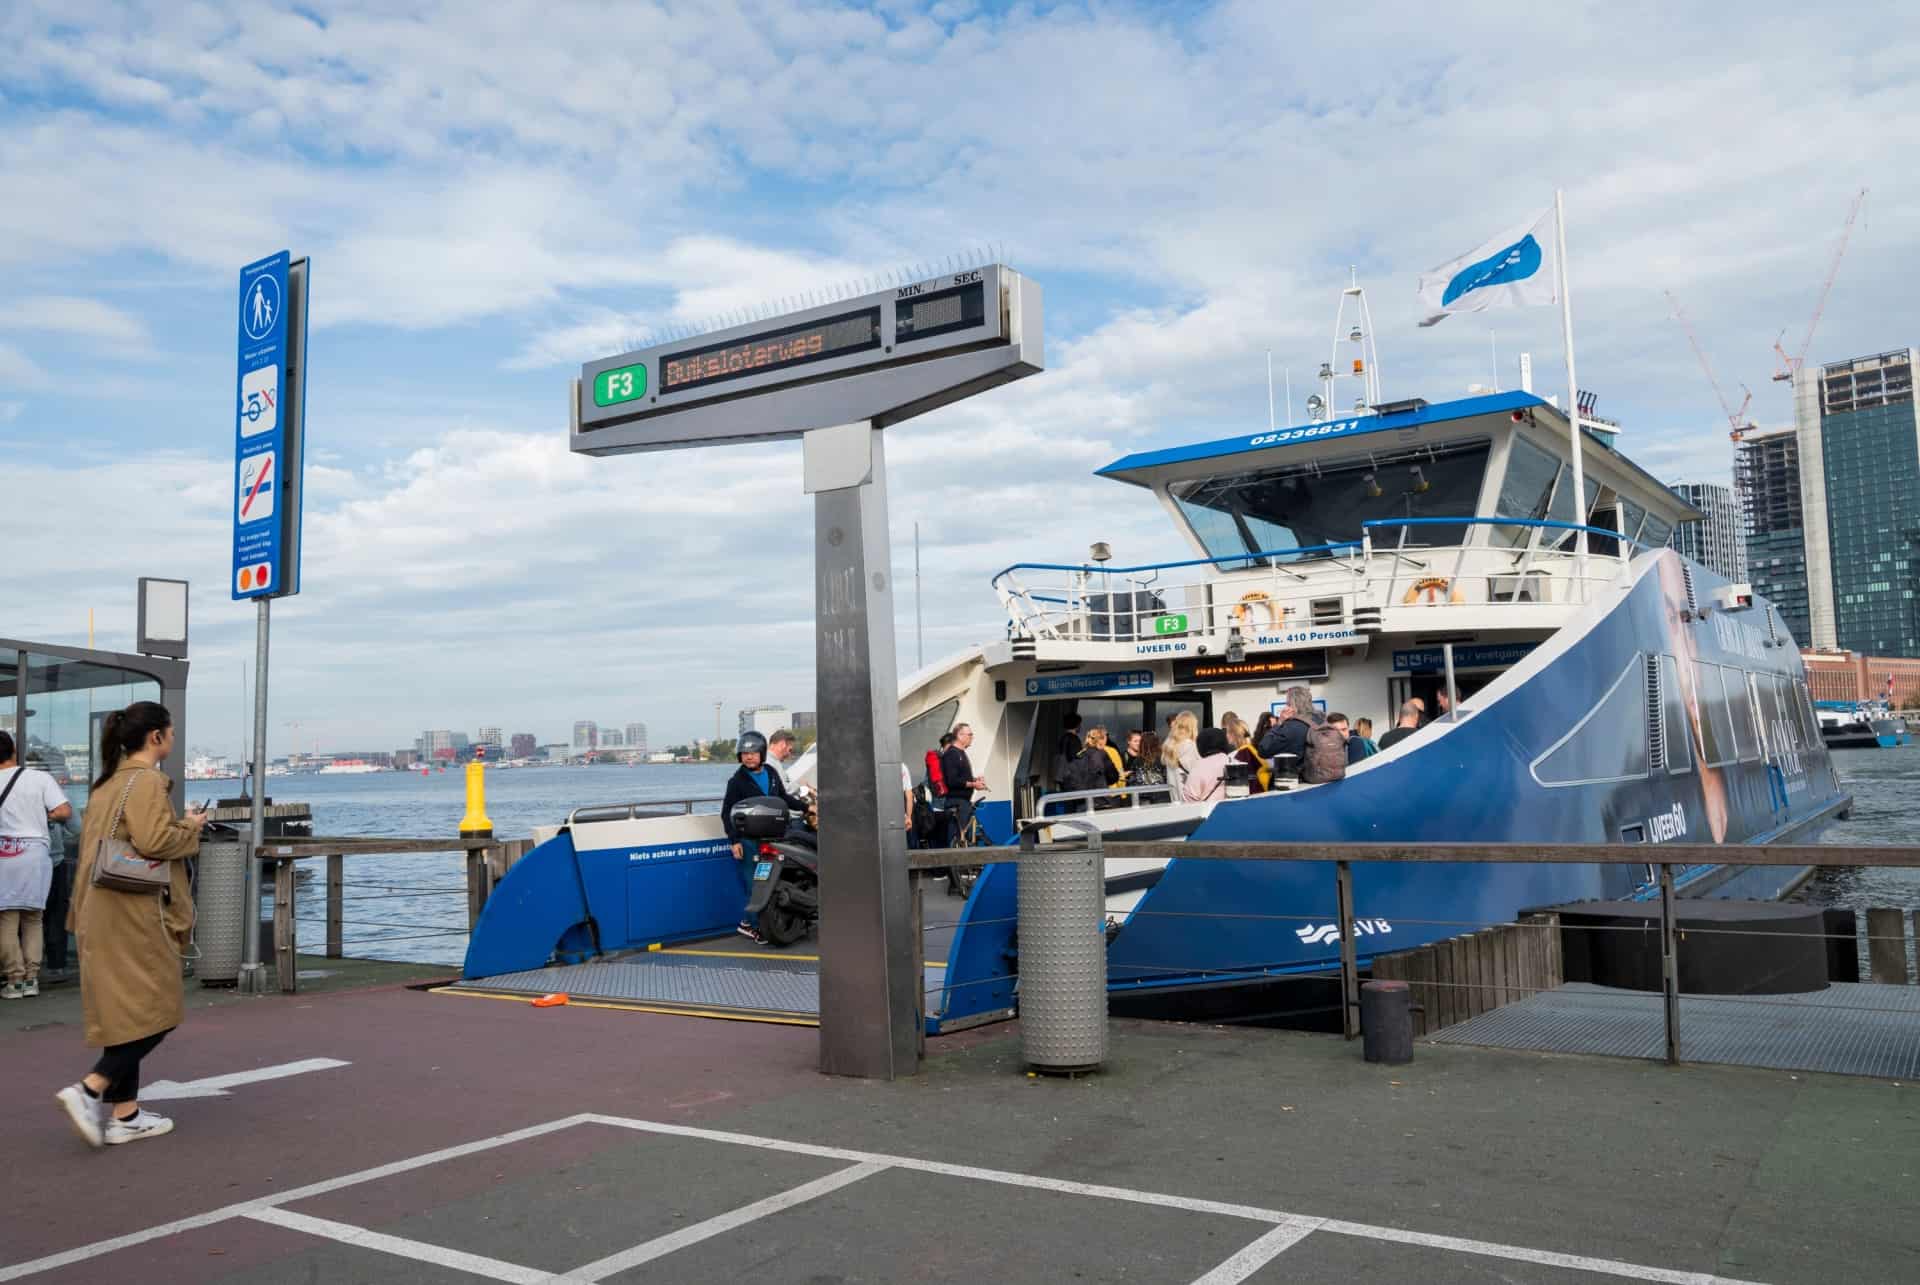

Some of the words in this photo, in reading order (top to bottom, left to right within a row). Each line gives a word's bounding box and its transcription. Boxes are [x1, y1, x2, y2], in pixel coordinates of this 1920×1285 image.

[954, 271, 983, 286] SEC.
[607, 372, 633, 400] F3
[1250, 420, 1359, 446] 02336831
[1163, 618, 1179, 632] F3
[1258, 635, 1284, 646] Max.
[1287, 632, 1306, 643] 410
[1174, 642, 1187, 651] 60
[677, 847, 687, 856] de
